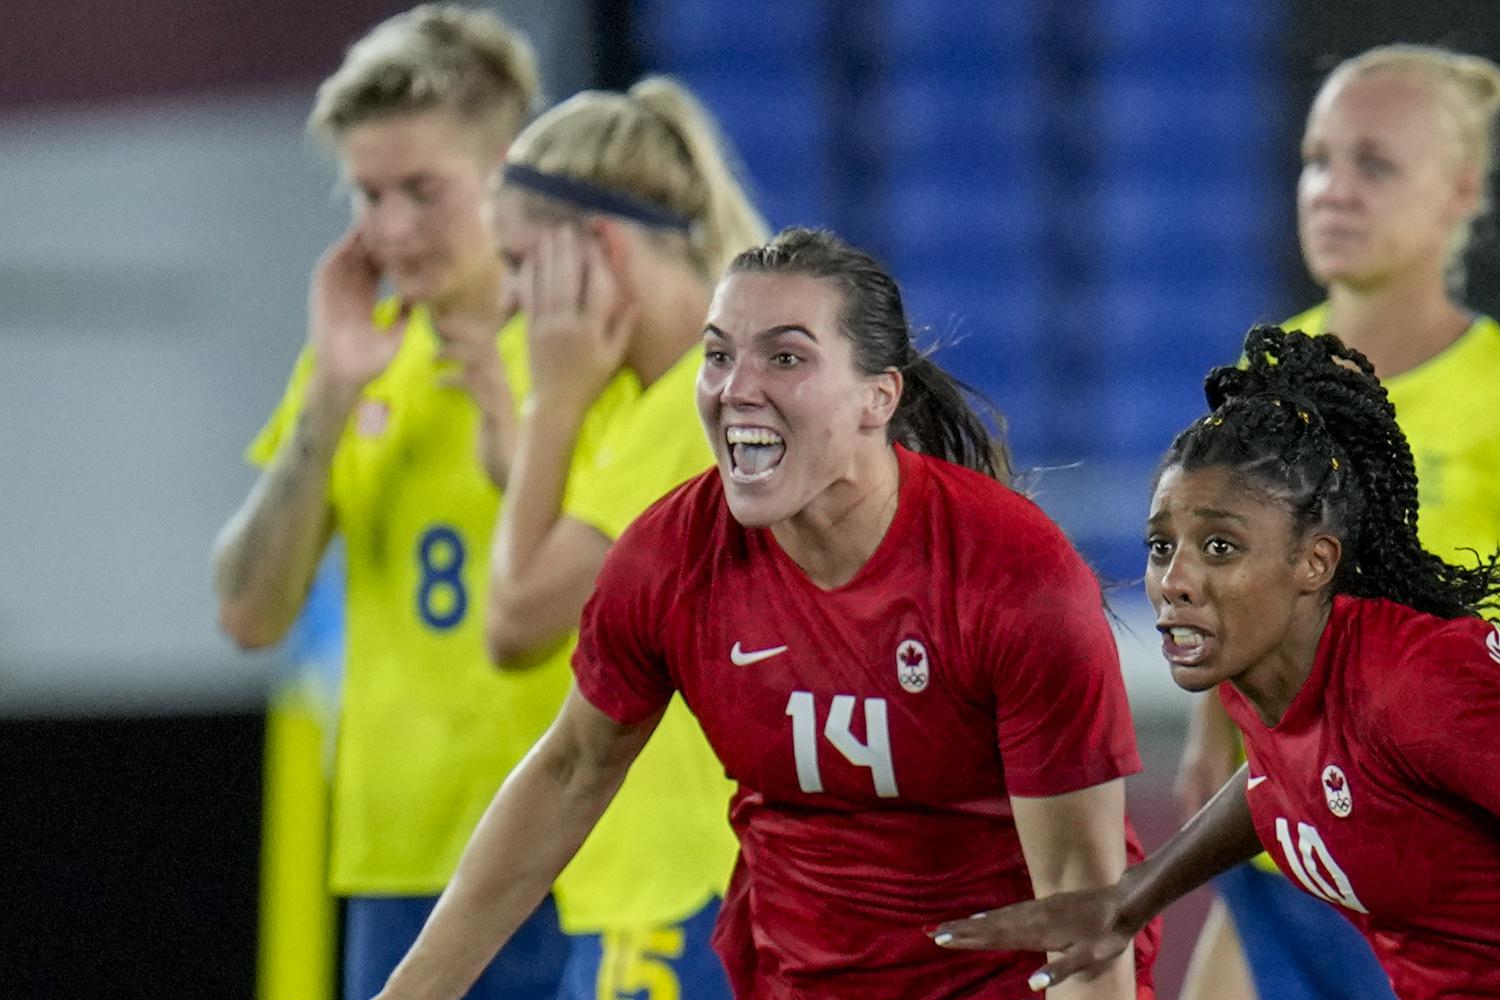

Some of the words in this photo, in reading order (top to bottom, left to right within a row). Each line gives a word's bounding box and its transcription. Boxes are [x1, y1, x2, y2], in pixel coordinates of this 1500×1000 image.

[418, 524, 468, 631] 8
[785, 690, 899, 799] 14
[1275, 817, 1370, 914] 10
